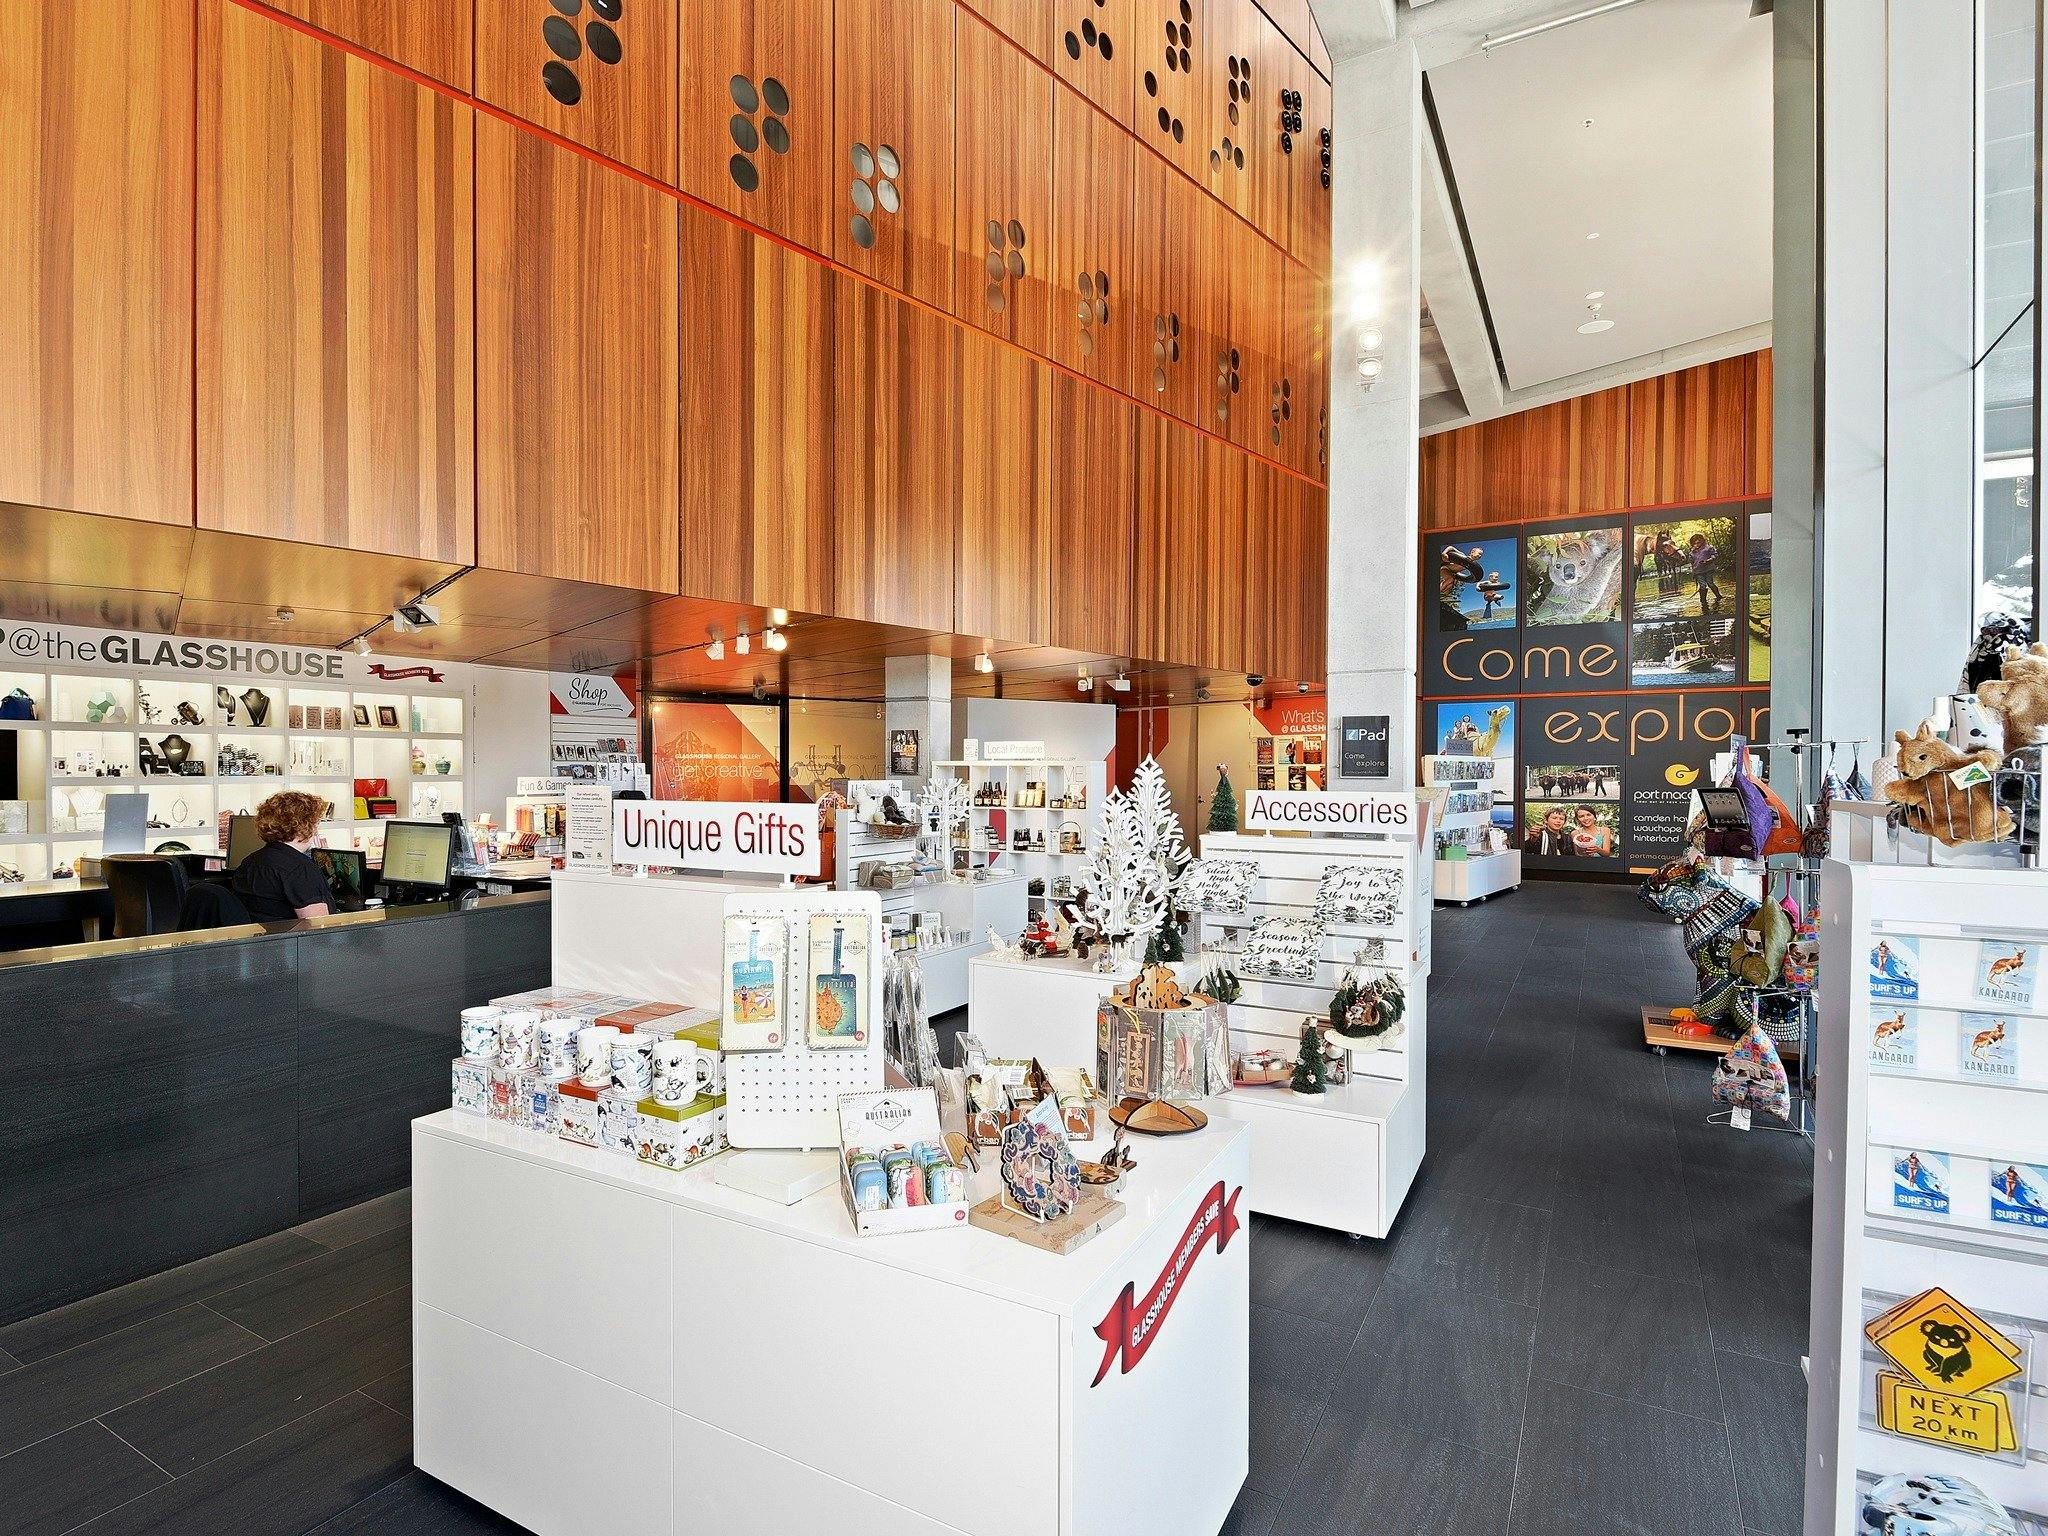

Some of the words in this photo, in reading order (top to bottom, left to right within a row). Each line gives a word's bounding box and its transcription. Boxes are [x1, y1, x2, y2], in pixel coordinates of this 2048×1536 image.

[0, 627, 344, 679] @theGLASSHOUSE
[1443, 638, 1618, 681] Come
[569, 677, 608, 705] Shop
[1281, 708, 1325, 723] What's
[1344, 752, 1366, 760] Come
[673, 763, 700, 782] get
[704, 763, 763, 778] creative
[1633, 789, 1660, 802] port
[1250, 795, 1408, 825] Accessories
[1633, 814, 1671, 822] camden
[624, 809, 721, 858] Unique
[735, 811, 805, 857] Gifts
[1633, 825, 1682, 834] wauchope
[1633, 834, 1680, 843] hinterland
[1196, 881, 1221, 889] Holy
[1368, 879, 1380, 888] to
[1203, 889, 1229, 897] Night
[1328, 891, 1345, 899] the
[1869, 983, 1900, 994] SURF'S
[1904, 985, 1917, 995] UP
[1978, 986, 2030, 1003] KANGAROO
[1964, 1060, 2015, 1075] KANGAROO
[1898, 1194, 1932, 1208] SURF'S
[1934, 1199, 1948, 1209] UP
[1995, 1209, 2031, 1223] SURF'S
[2033, 1214, 2048, 1224] UP
[1131, 1267, 1176, 1348] GLASSHOUSE
[1175, 1216, 1206, 1278] MEMBERS
[1204, 1199, 1220, 1227] SAVE
[1910, 1394, 1982, 1422] NEXT
[1912, 1416, 1942, 1432] 20
[1947, 1423, 1979, 1442] km
